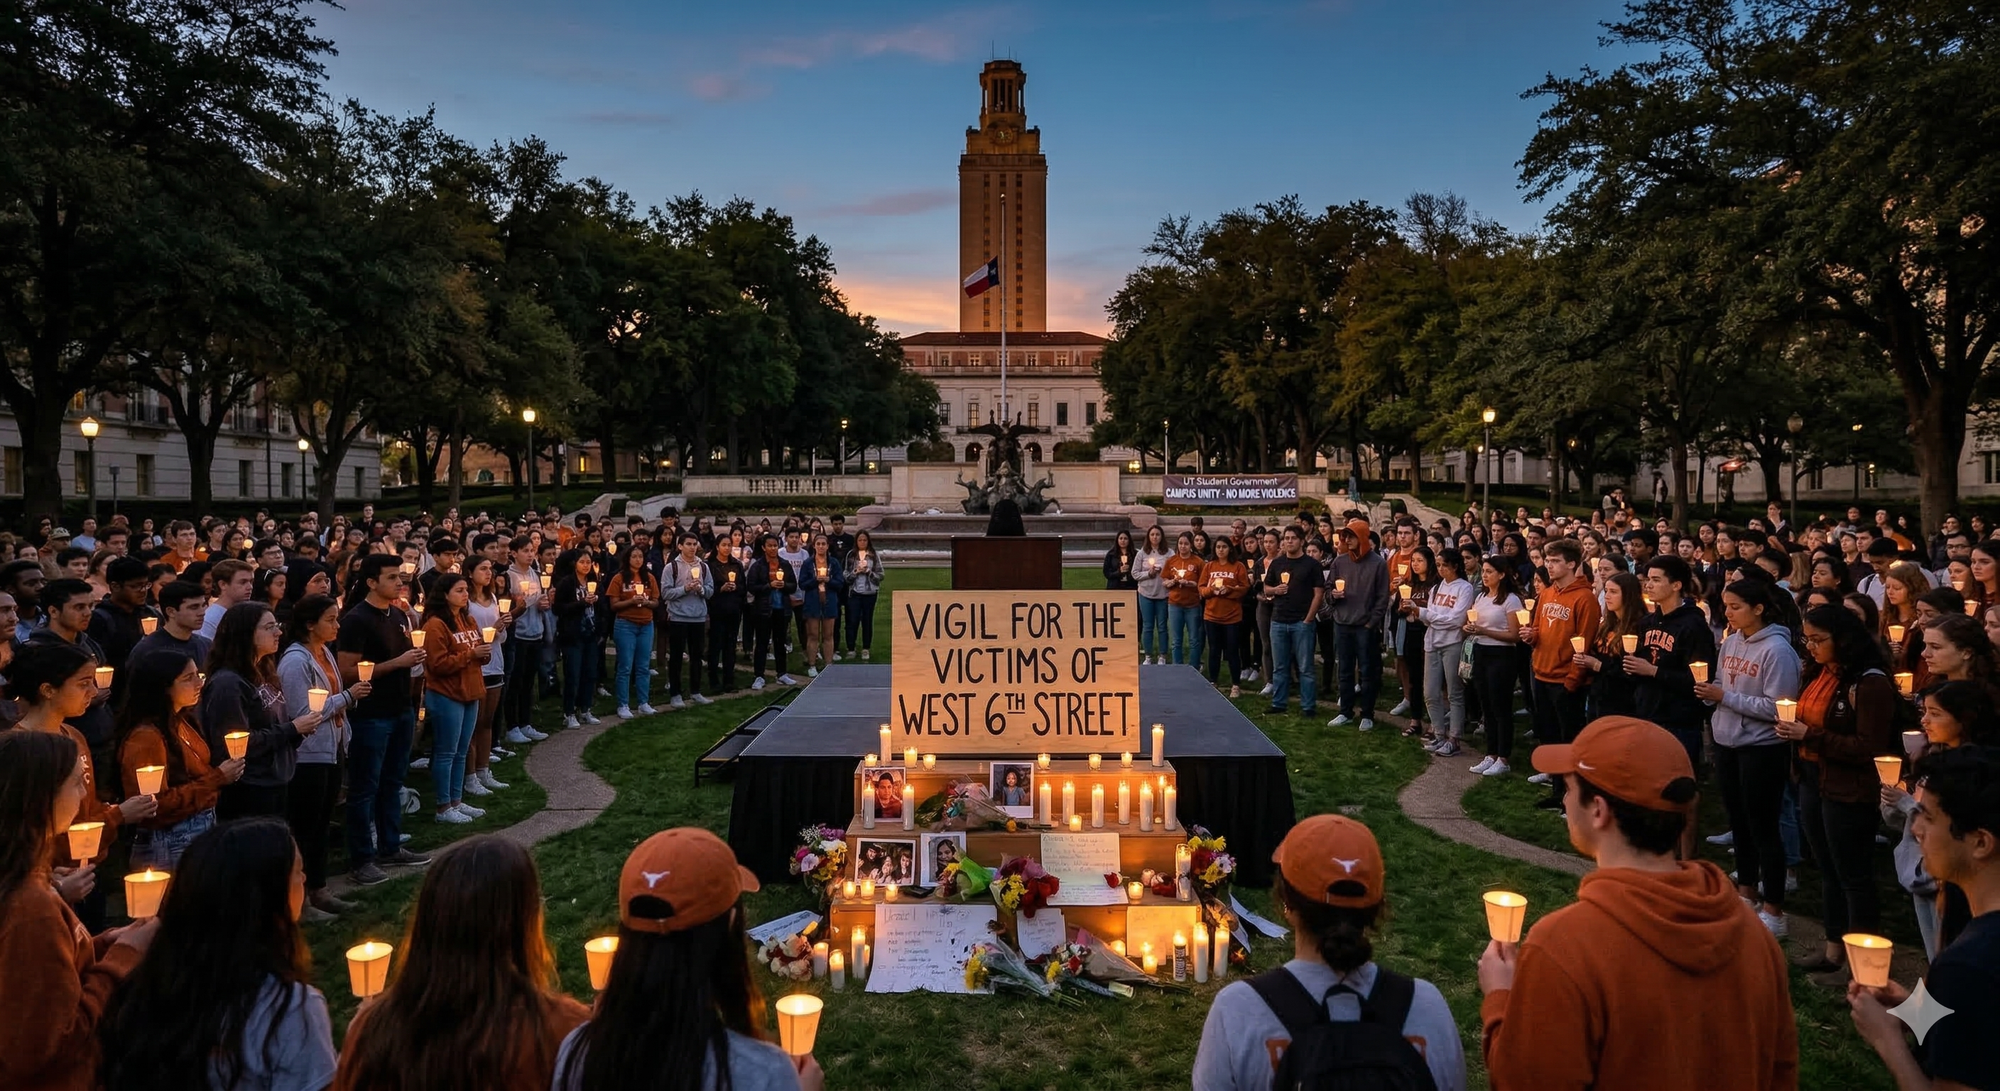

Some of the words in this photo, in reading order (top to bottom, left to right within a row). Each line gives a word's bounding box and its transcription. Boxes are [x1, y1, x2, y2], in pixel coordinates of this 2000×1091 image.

[1165, 488, 1197, 499] CAMPUS
[1197, 488, 1221, 499] UNITY
[1226, 488, 1238, 499] NO
[1238, 488, 1260, 499] MORE
[1183, 477, 1195, 486] UT
[1196, 477, 1228, 486] Student
[1229, 476, 1278, 487] Government
[905, 602, 998, 640] VIGIL
[1011, 602, 1063, 640] FOR
[1072, 602, 1126, 640] THE
[931, 647, 1058, 684] VICTIMS
[1071, 647, 1108, 683] OF
[898, 692, 977, 736] WEST
[985, 692, 1026, 736] 6TH
[1032, 692, 1133, 736] STREET
